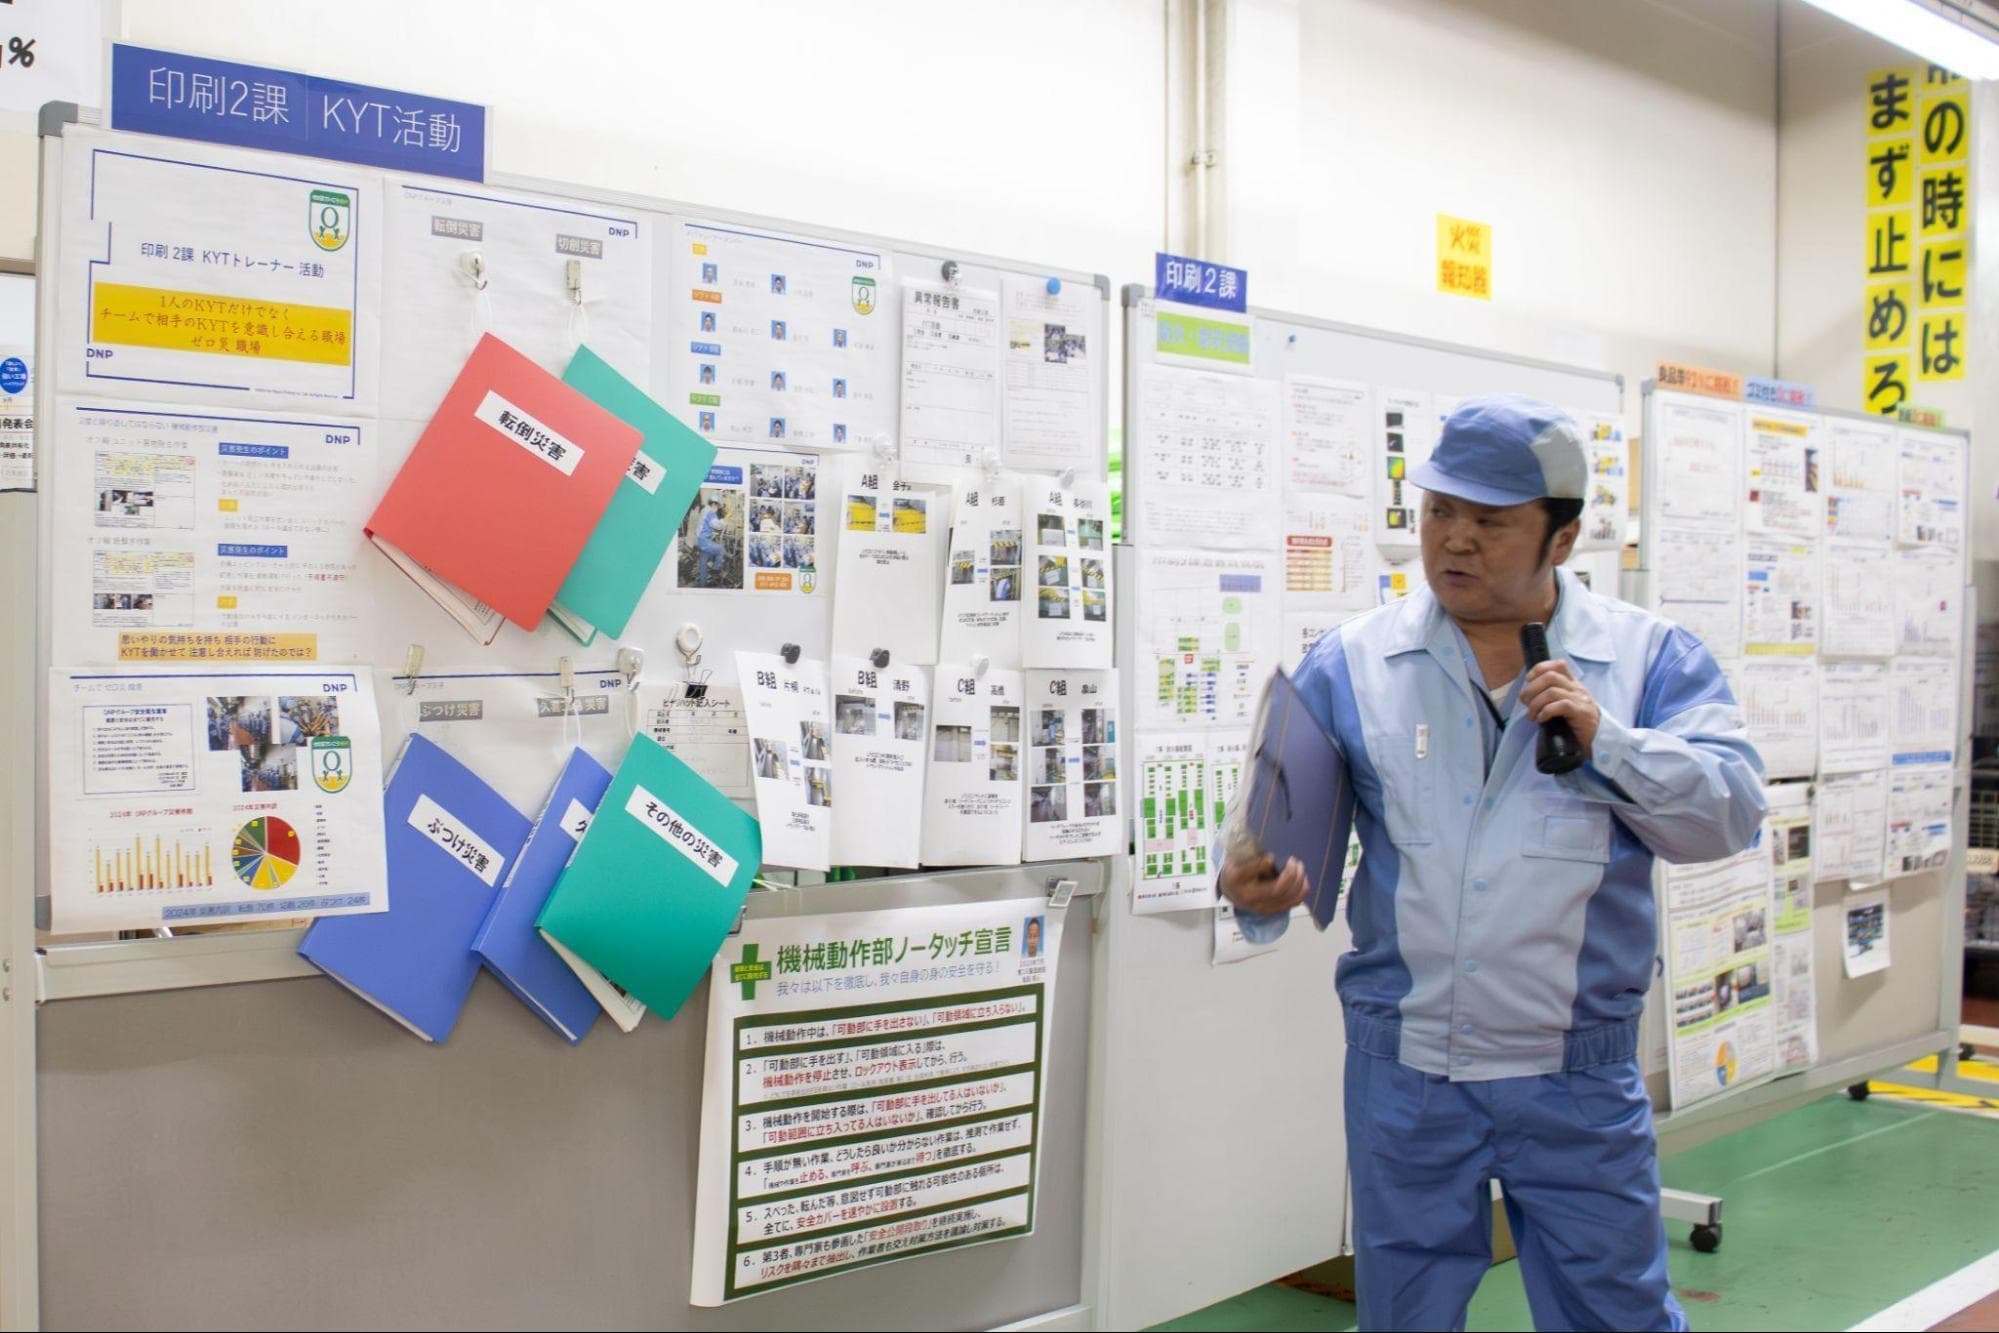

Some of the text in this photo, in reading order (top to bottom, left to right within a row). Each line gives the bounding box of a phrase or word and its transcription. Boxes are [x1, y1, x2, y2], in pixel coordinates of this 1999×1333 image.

[149, 66, 462, 153] 印刷2課 KYT活動
[608, 227, 629, 237] DNP
[1868, 73, 1911, 415] まず止めろ
[141, 243, 325, 278] 印刷 2課 KYTトレーナー 活動
[1166, 261, 1237, 299] 印刷2課
[86, 348, 113, 359] DNP
[0, 418, 33, 429] 発表会
[325, 434, 351, 445] DNP
[499, 410, 566, 462] 転倒災害
[322, 684, 348, 693] DNP
[600, 679, 621, 688] DNP
[756, 671, 777, 690] B組
[858, 670, 878, 689] B組
[957, 678, 976, 695] C組
[1049, 680, 1067, 696] C組
[421, 702, 481, 718] ぶつけ災害
[645, 800, 723, 868] その他の災害
[427, 817, 491, 874] ぶつけ災害
[777, 926, 1012, 975] 機械動作部ノータッチ宣言
